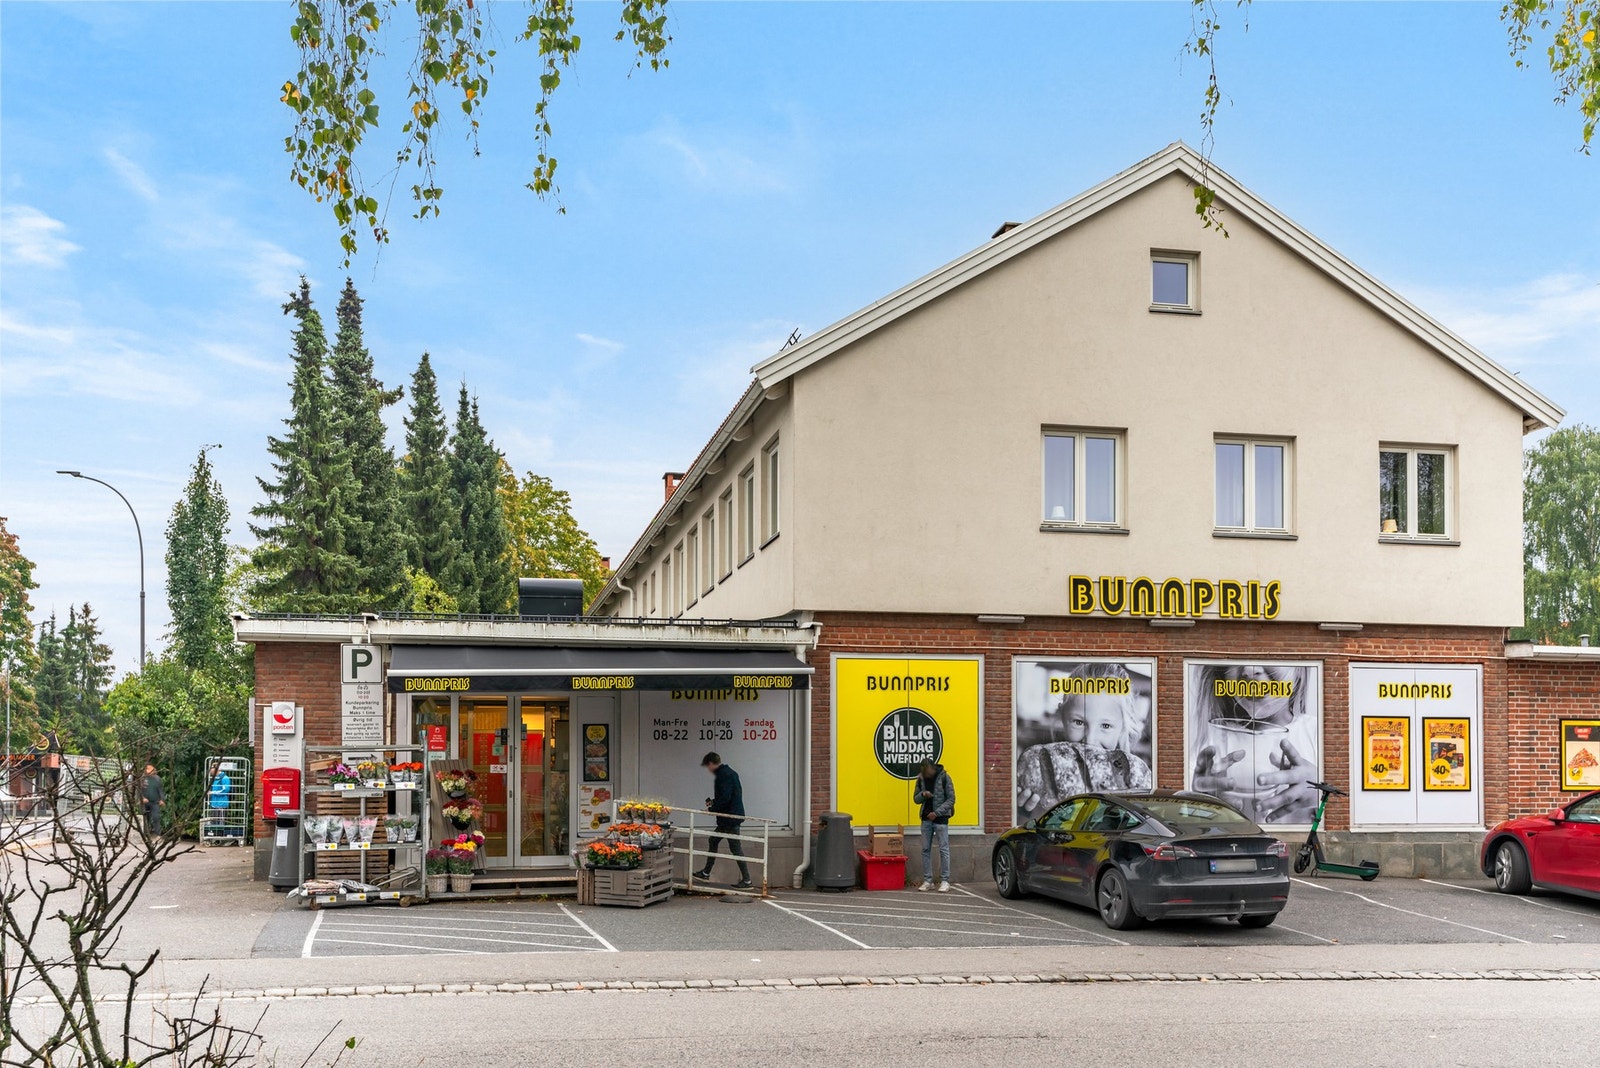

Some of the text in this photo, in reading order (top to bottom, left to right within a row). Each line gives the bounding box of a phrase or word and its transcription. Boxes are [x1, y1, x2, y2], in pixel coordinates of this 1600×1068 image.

[1069, 575, 1282, 619] BUNNPRIS
[351, 649, 373, 679] P
[404, 677, 471, 692] BUNNPRIS
[572, 675, 635, 690] BUNNPRIS
[733, 674, 793, 689] BUNNPRIS
[866, 675, 951, 692] BUNNPRIS
[1050, 677, 1131, 695] BUNNPRIS
[1214, 679, 1293, 697] BUNNPRIS
[1378, 683, 1453, 699] BUNNPRIS
[653, 718, 775, 729] Man-Fre Lørdag Søndag
[653, 729, 777, 741] 08-22 10-20 10-20
[883, 724, 934, 741] BILLIG
[883, 740, 934, 754] MIDDAG
